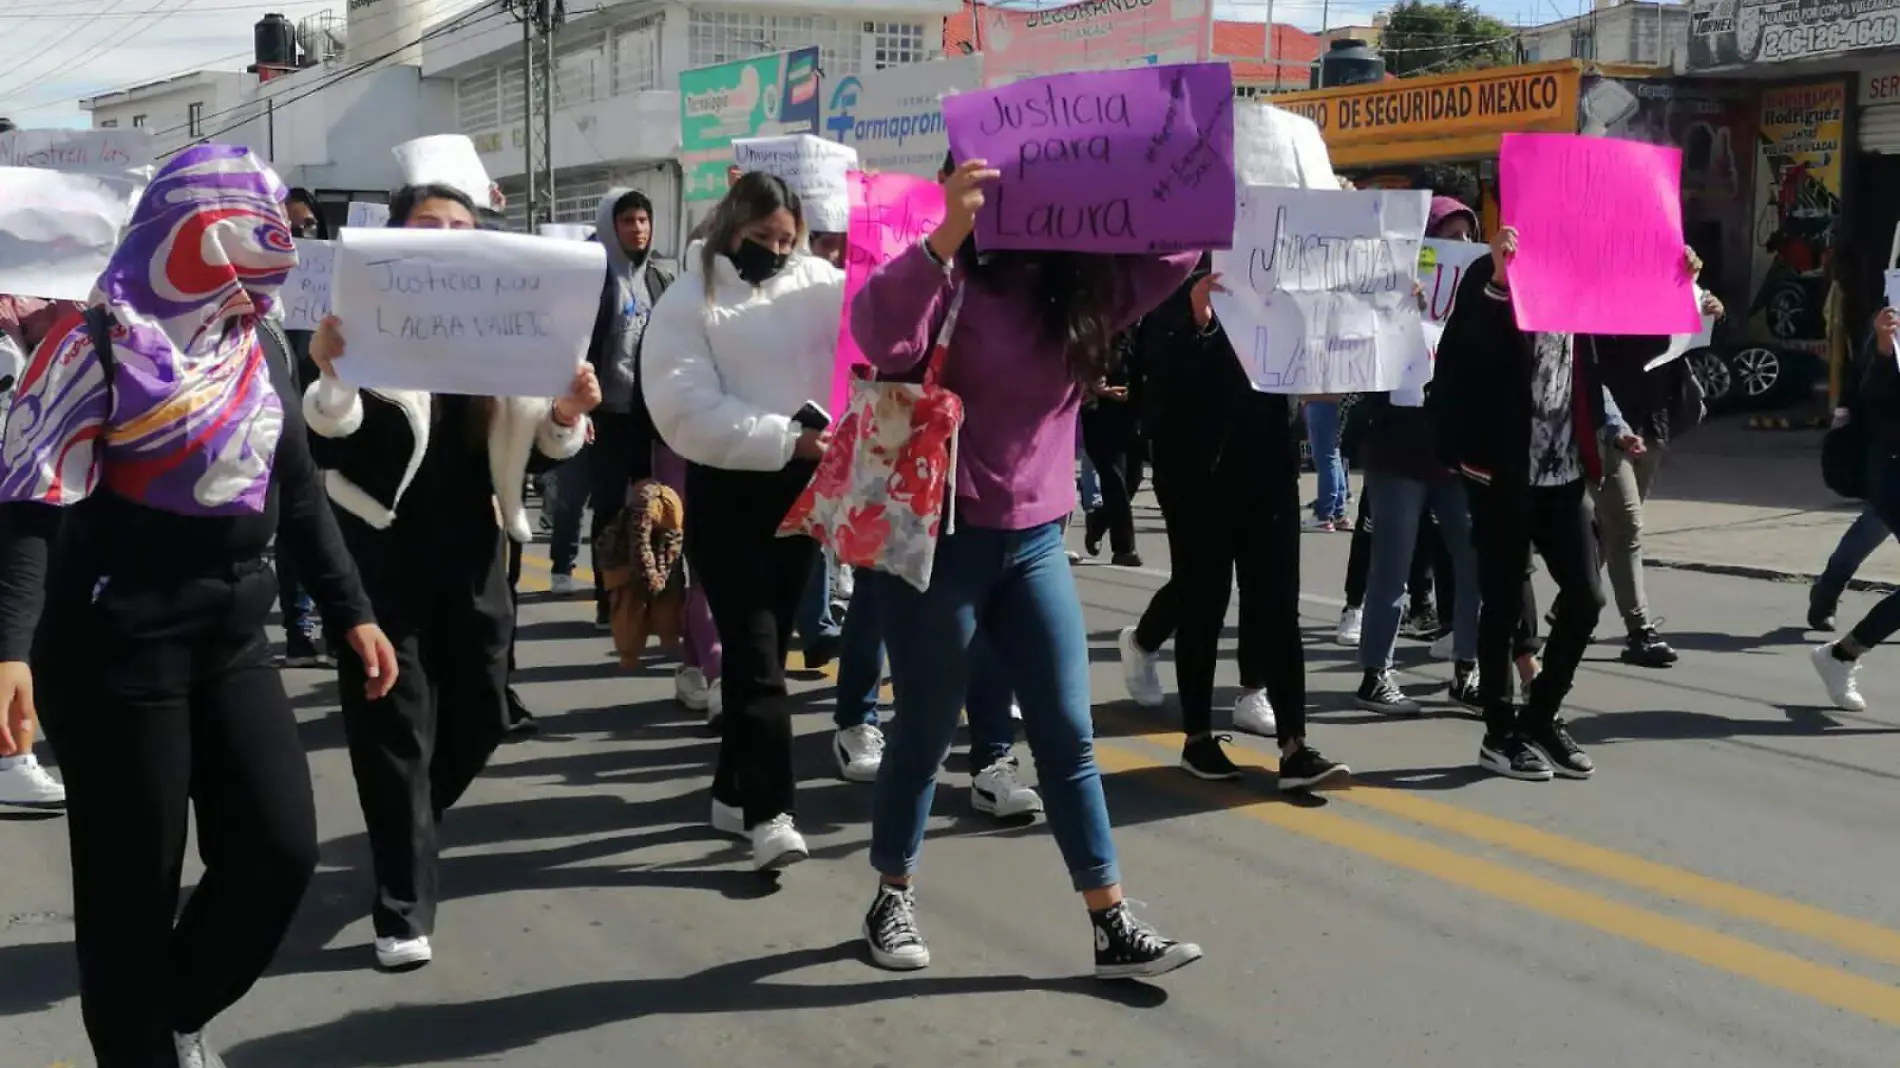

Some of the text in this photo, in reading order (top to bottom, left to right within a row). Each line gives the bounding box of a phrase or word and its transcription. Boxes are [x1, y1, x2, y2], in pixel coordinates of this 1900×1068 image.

[980, 84, 1130, 136] Justicia
[1338, 98, 1362, 130] DE
[1365, 86, 1473, 127] SEGURIDAD
[1478, 76, 1558, 116] MEXICO
[98, 138, 130, 166] las
[1019, 135, 1110, 180] para
[996, 186, 1137, 240] Laura
[366, 257, 483, 293] Justicia
[1250, 204, 1397, 295] JUSTICIA
